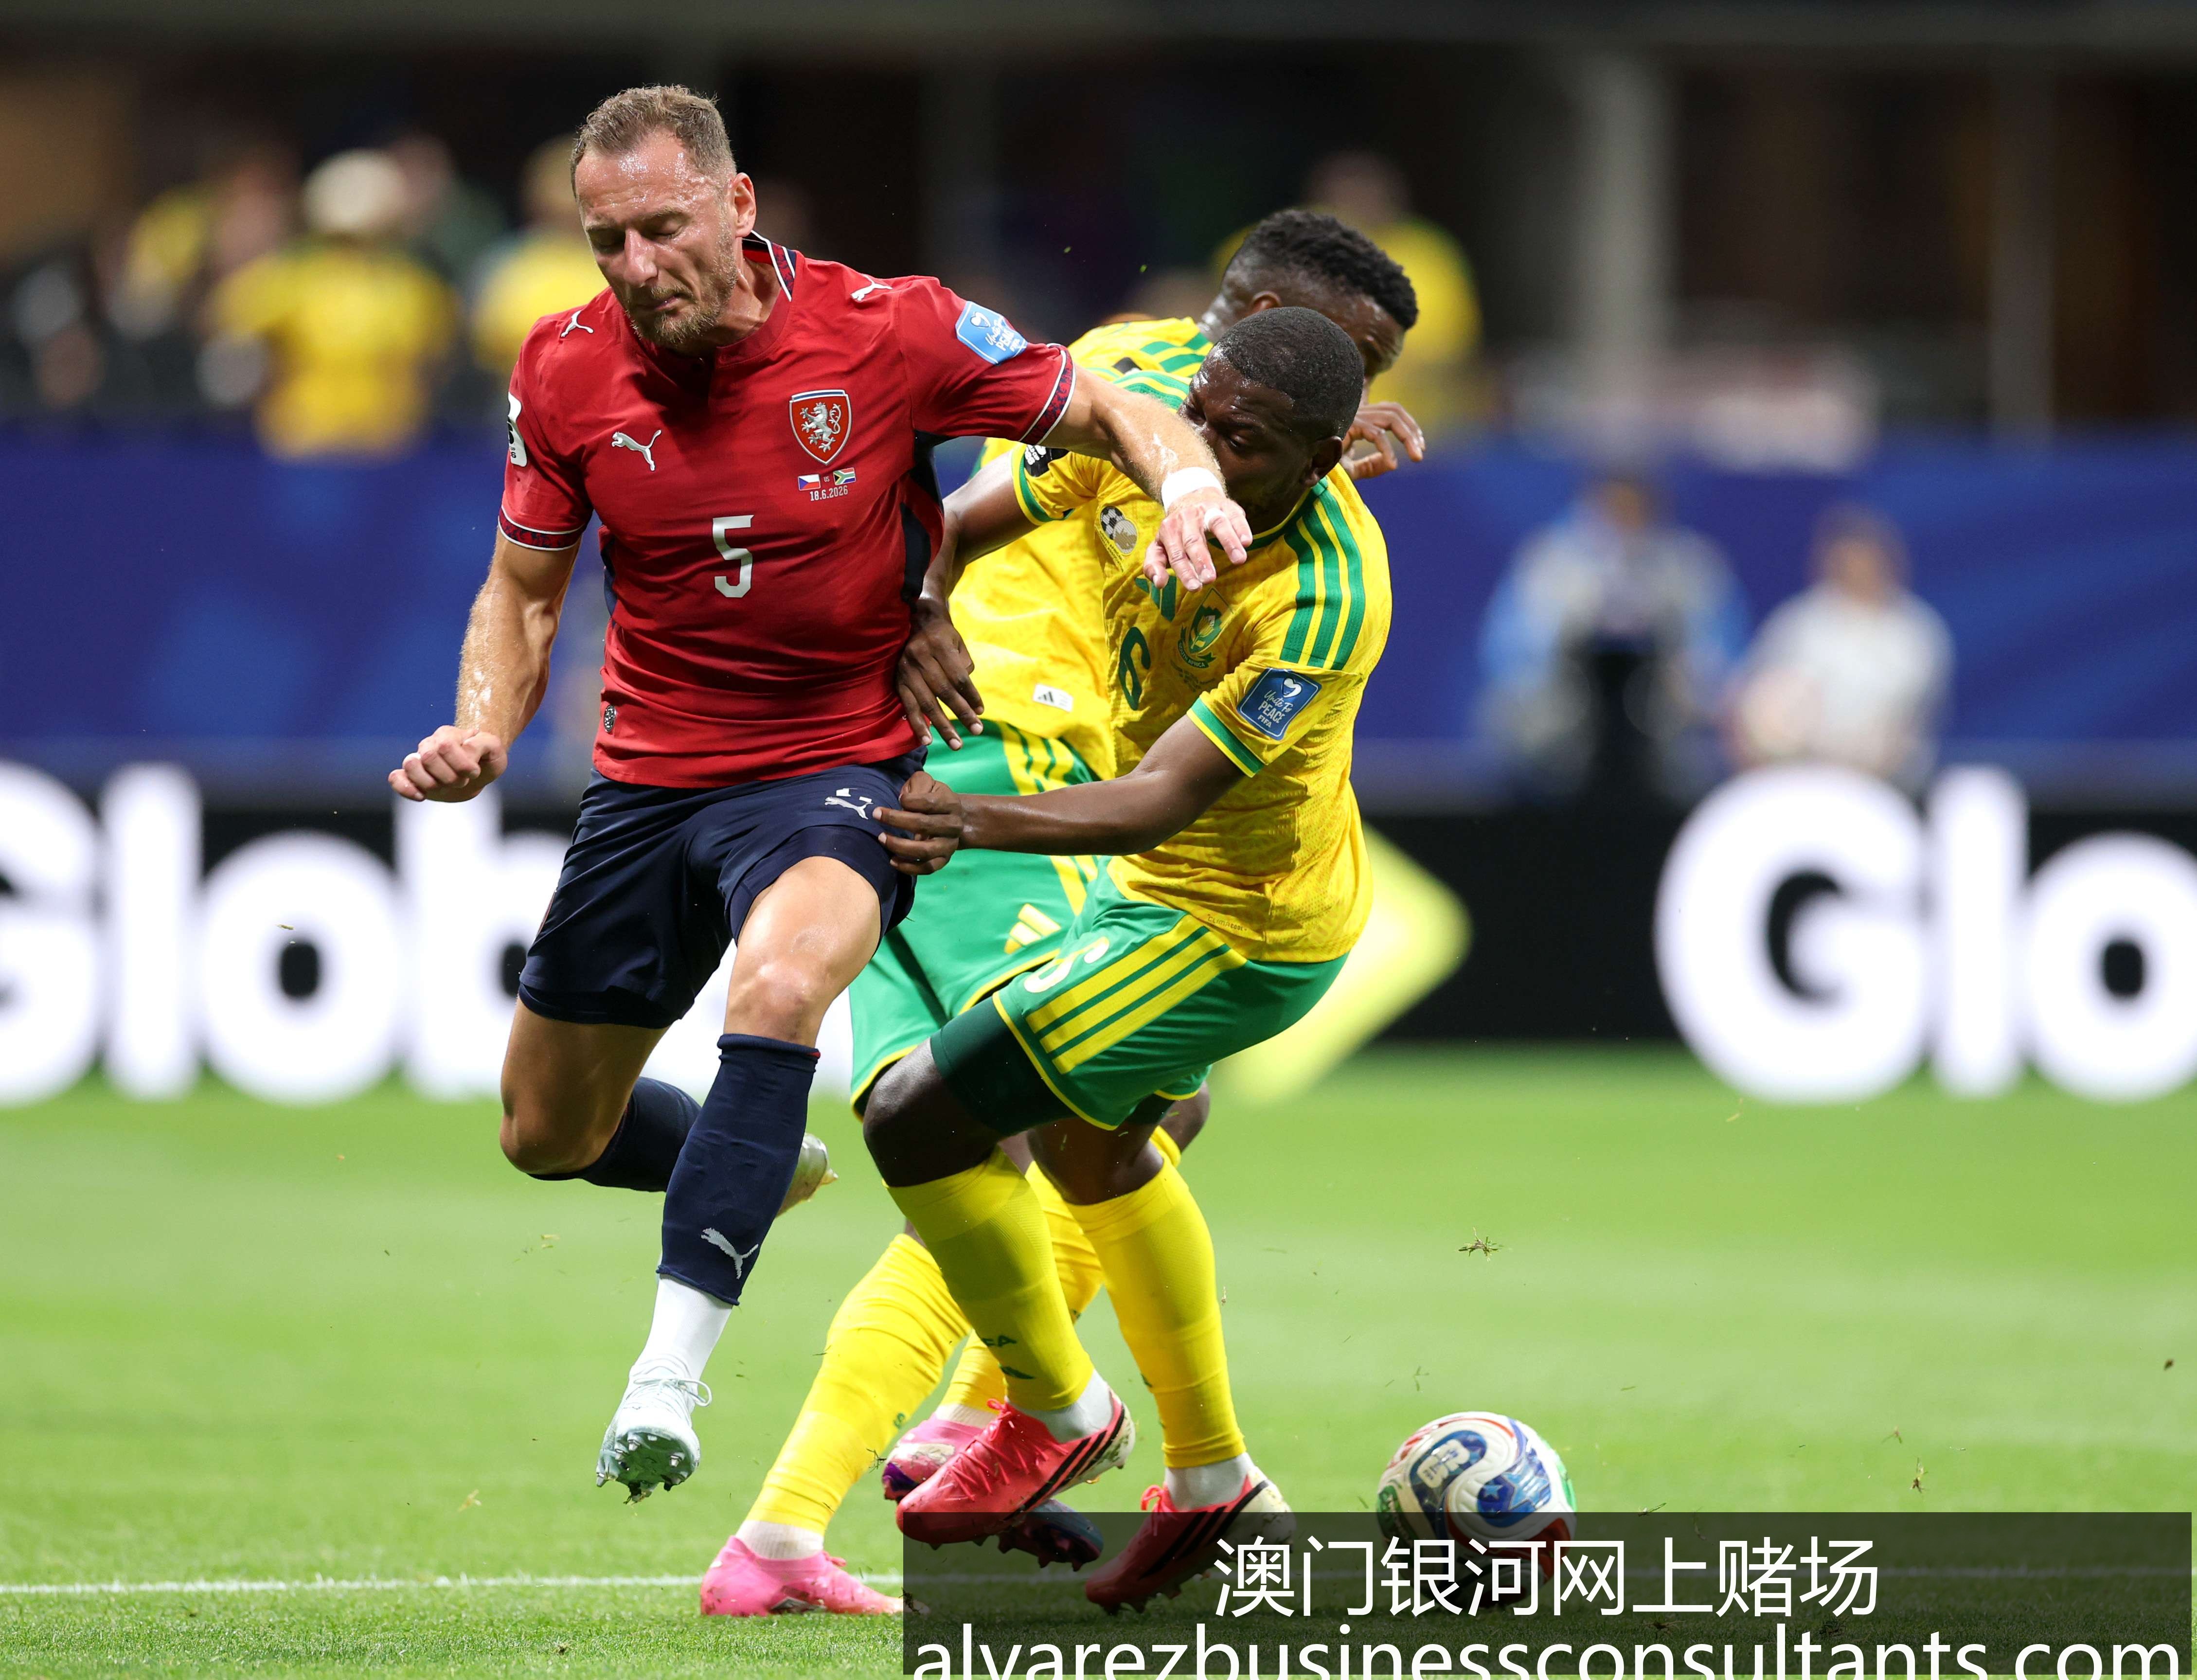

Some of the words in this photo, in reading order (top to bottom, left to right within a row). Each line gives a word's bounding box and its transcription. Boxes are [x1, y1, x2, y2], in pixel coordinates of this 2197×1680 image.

[809, 485, 848, 501] 18.6.2026
[713, 515, 754, 598] 5
[1118, 626, 1151, 711] 6
[1188, 659, 1206, 668] AFRICA
[1264, 690, 1284, 707] Unite
[1258, 700, 1286, 723] PEACE
[1257, 715, 1273, 728] FIFA
